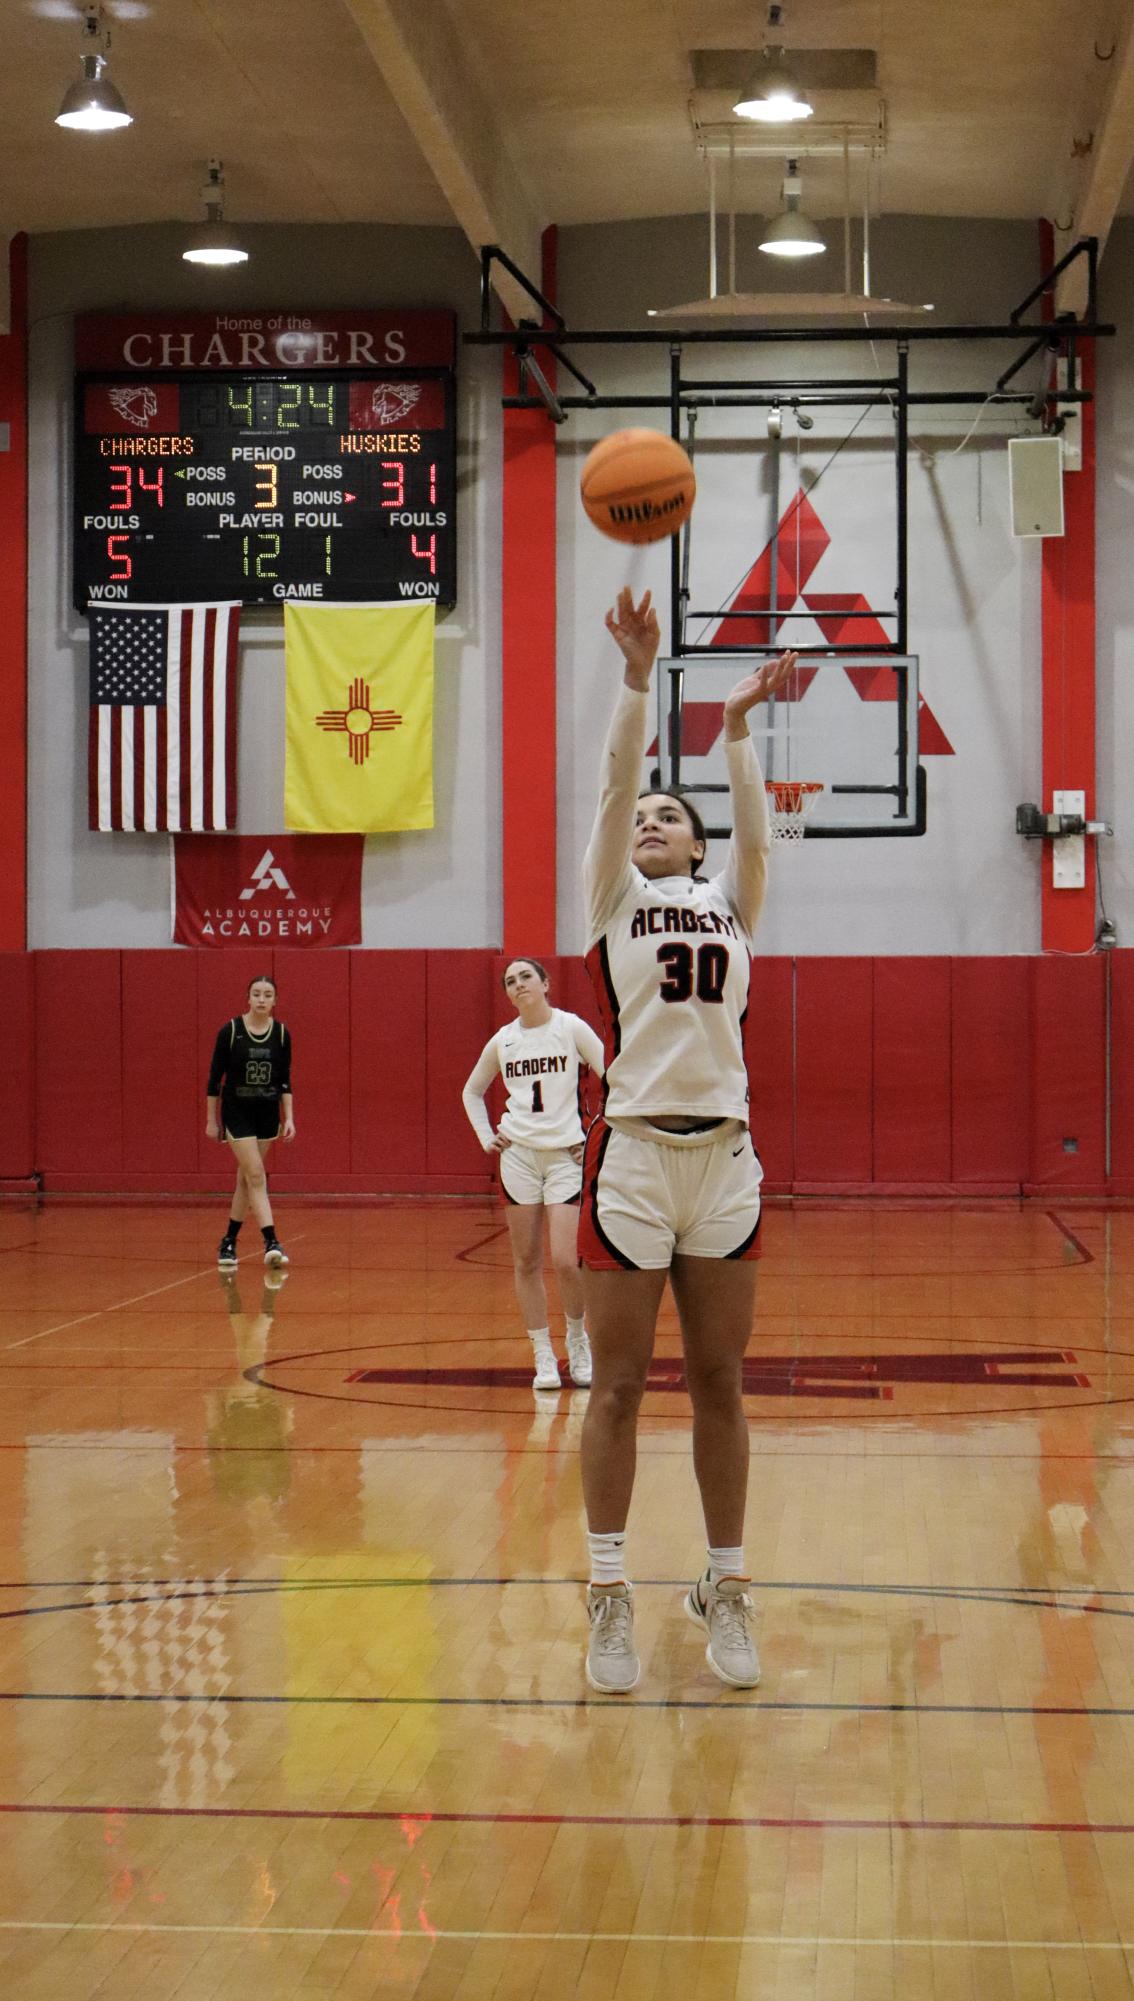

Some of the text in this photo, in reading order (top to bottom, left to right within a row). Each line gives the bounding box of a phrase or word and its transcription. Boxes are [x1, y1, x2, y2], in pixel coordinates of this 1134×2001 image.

[216, 315, 312, 331] Home of the
[123, 330, 406, 367] CHARGERS
[228, 384, 334, 428] 4:24
[100, 437, 195, 456] CHARGERS
[340, 434, 421, 453] HUSKIES
[232, 446, 296, 461] PERIOD
[186, 466, 226, 481] POSS
[302, 465, 343, 479] POSS
[109, 465, 165, 510] 34
[254, 463, 277, 509] 3
[381, 462, 436, 508] 31
[186, 492, 236, 506] BONUS
[293, 491, 343, 505] BONUS
[608, 490, 685, 524] Wilson
[84, 515, 140, 529] FOULS
[219, 512, 343, 528] PLAYER FOUL
[390, 512, 447, 526] FOULS
[107, 535, 132, 580] 5
[242, 534, 280, 578] 12
[325, 534, 332, 576] 1
[411, 534, 436, 576] 4
[88, 585, 129, 599] WON
[272, 583, 324, 598] GAME
[399, 582, 440, 597] WON
[203, 907, 332, 920] ALBUQUERQUE
[201, 919, 332, 936] ACADEMY
[631, 906, 738, 941] ACADEMY
[656, 941, 730, 1004] 30
[246, 1060, 272, 1085] 23
[505, 1055, 568, 1079] ACADEMY
[531, 1079, 544, 1113] 1
